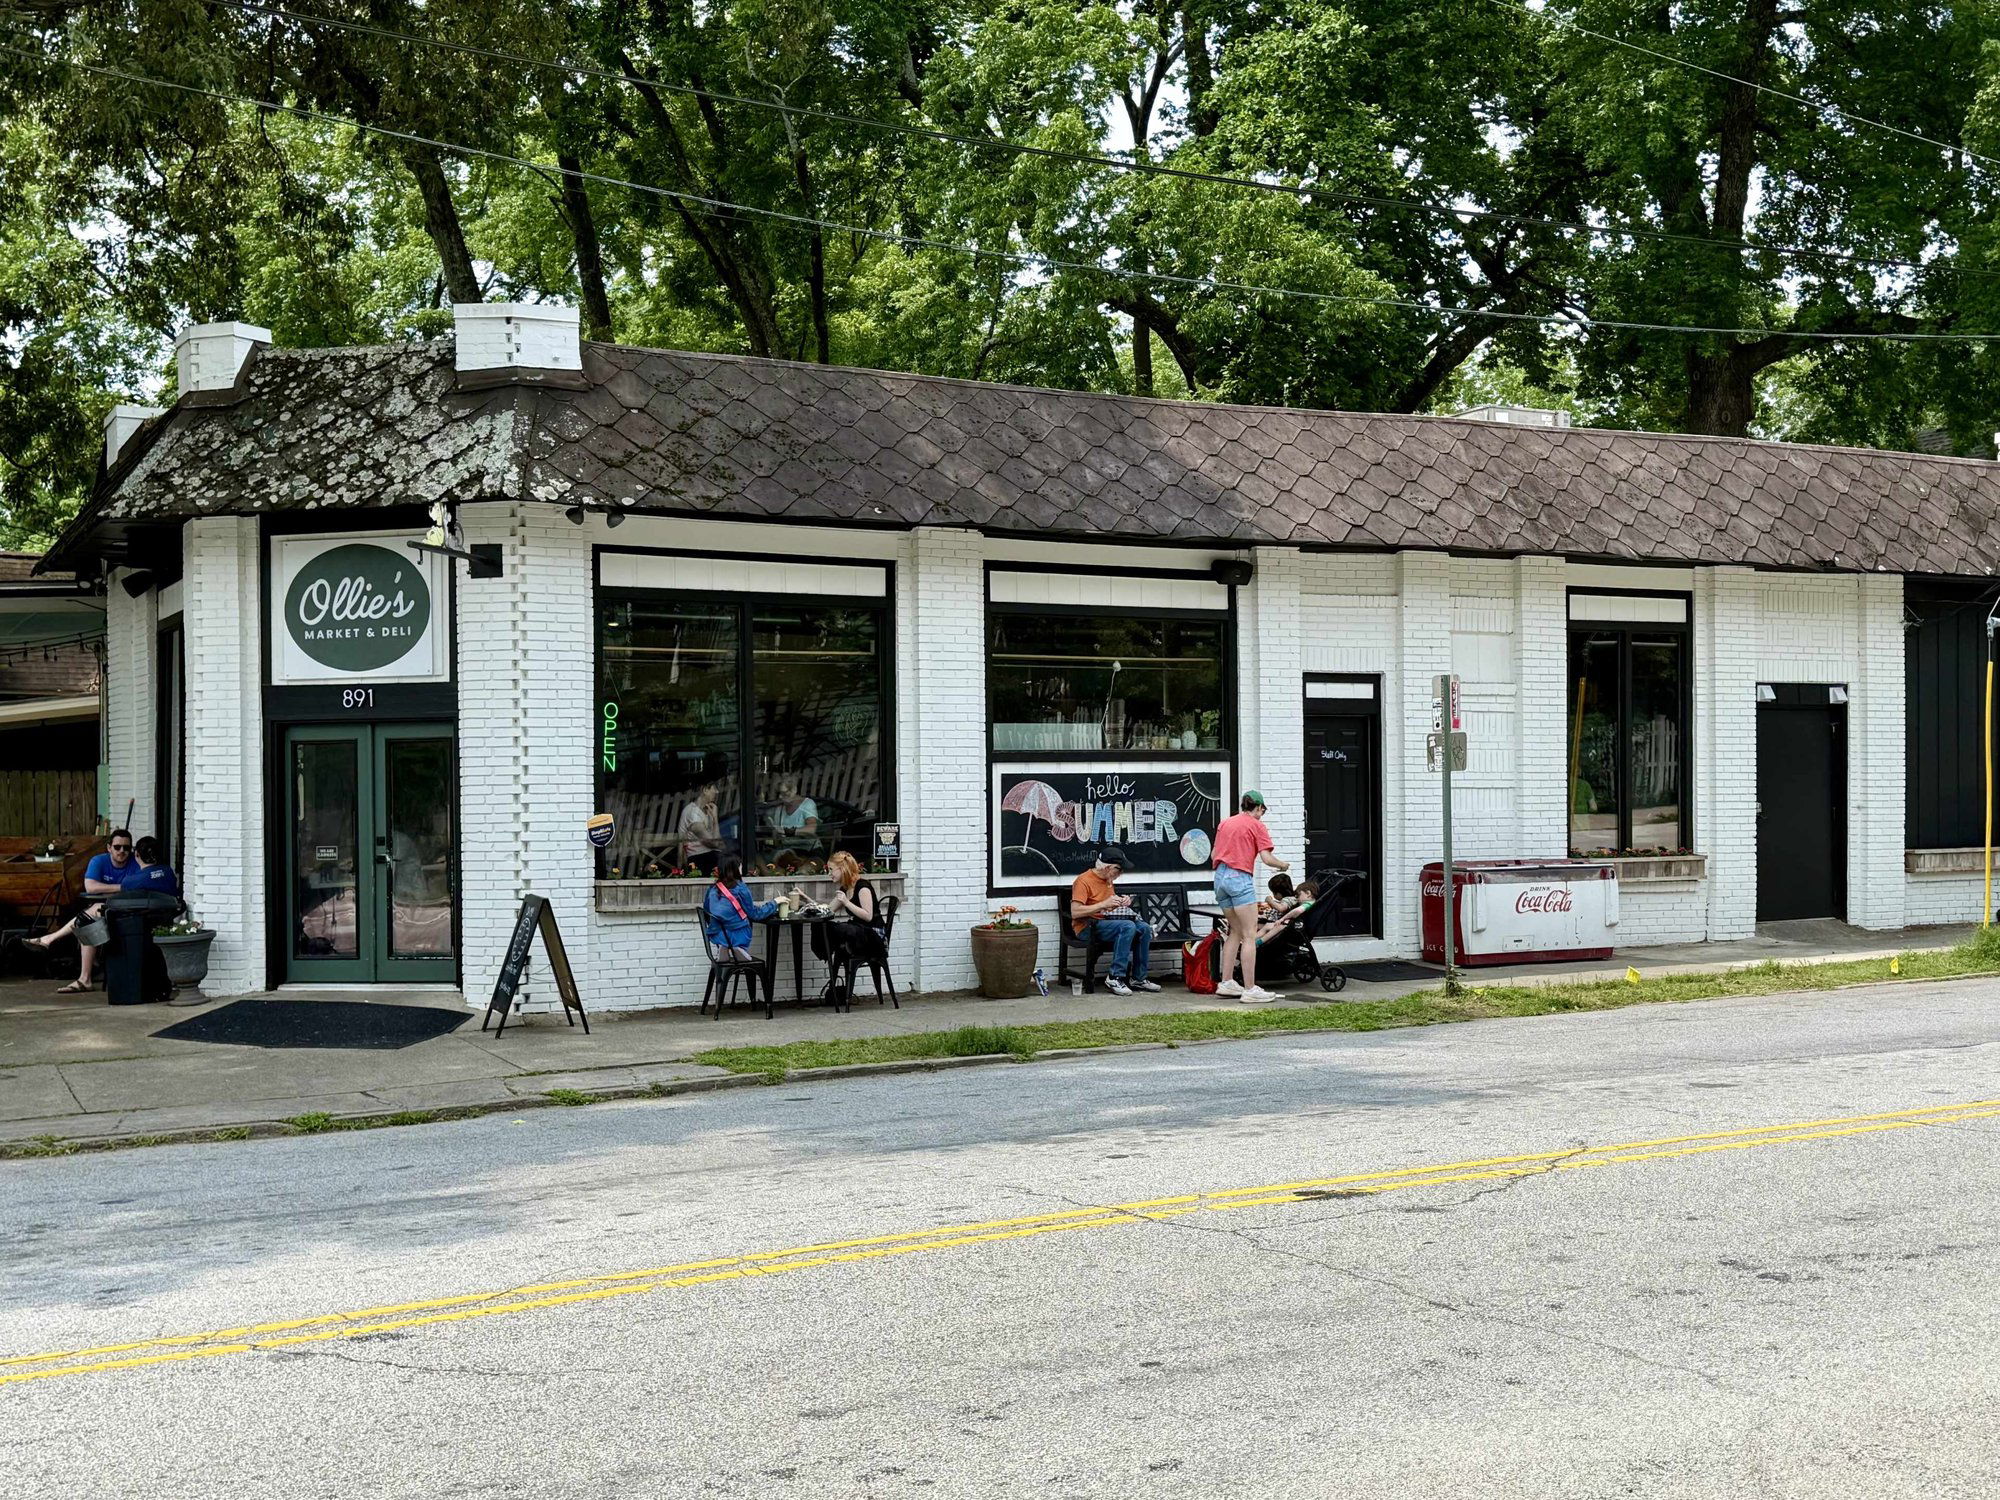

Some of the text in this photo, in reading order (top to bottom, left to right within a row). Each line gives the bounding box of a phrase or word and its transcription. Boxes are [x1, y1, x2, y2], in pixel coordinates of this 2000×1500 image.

[299, 570, 415, 626] Ollie's
[304, 626, 411, 640] MARKET & DELI
[342, 688, 374, 708] 891
[603, 702, 619, 773] OPEN
[1051, 800, 1178, 843] SUMMER
[1515, 890, 1573, 914] Coca-Cola
